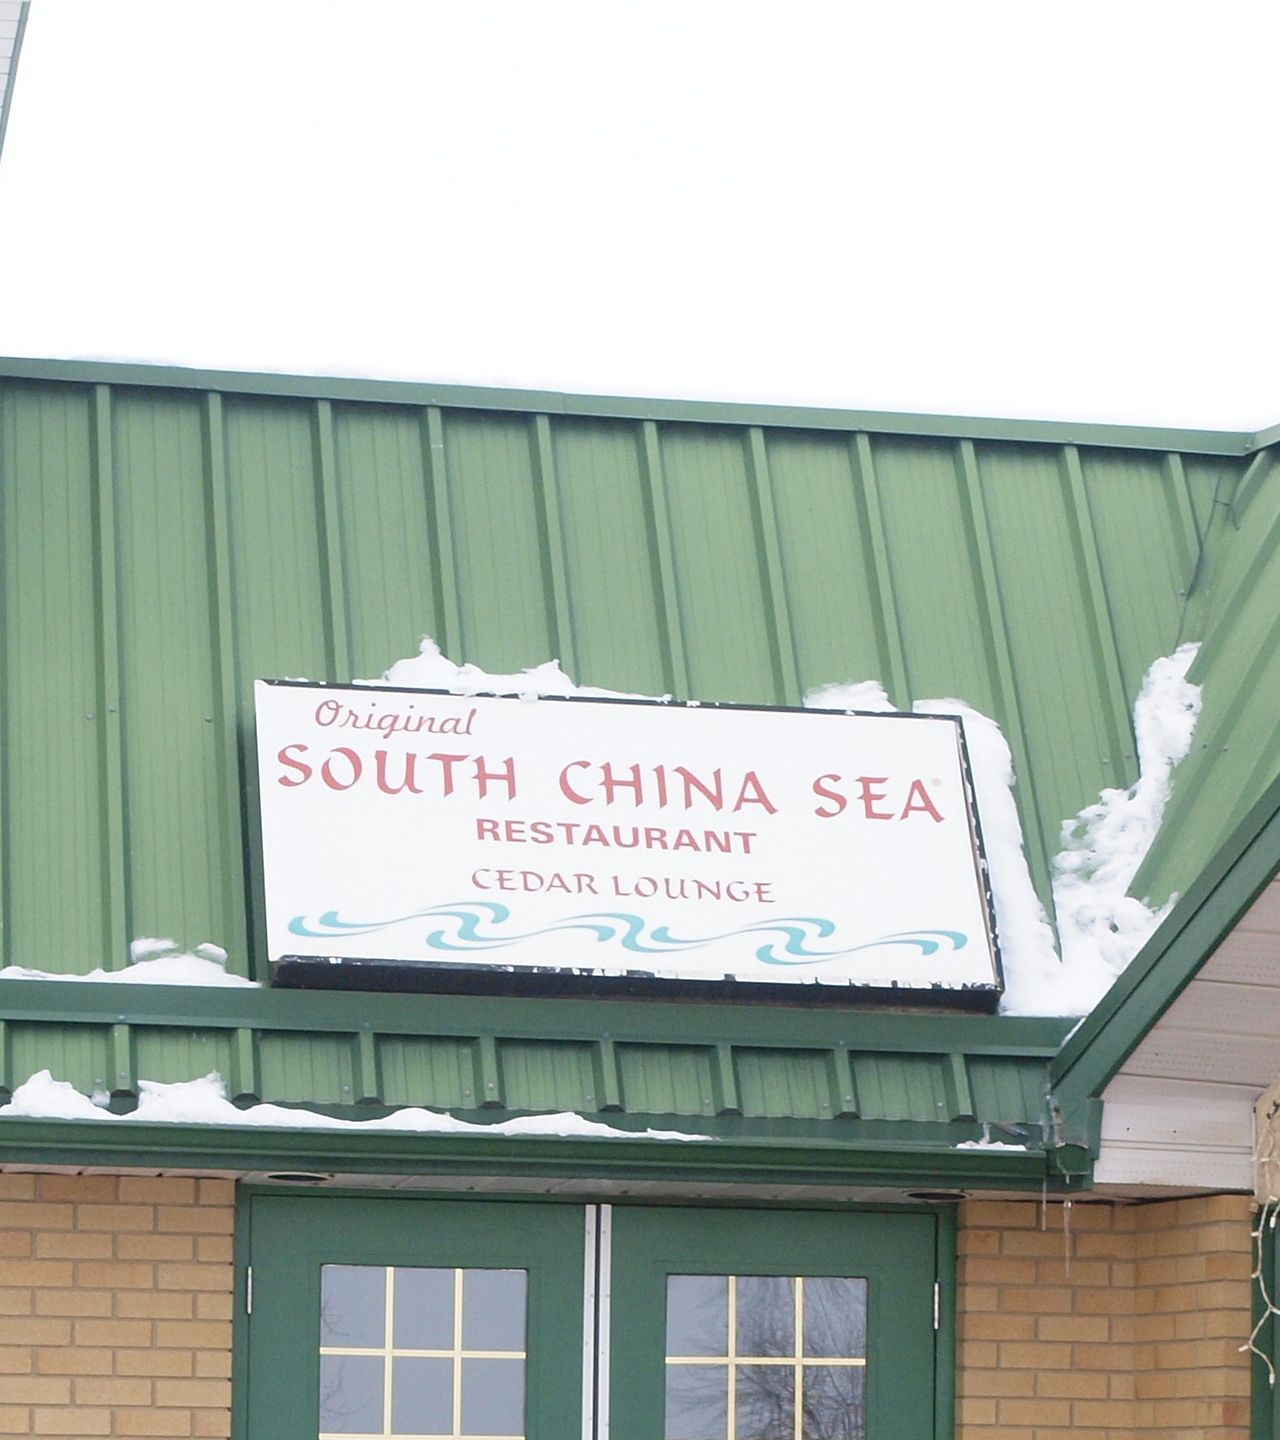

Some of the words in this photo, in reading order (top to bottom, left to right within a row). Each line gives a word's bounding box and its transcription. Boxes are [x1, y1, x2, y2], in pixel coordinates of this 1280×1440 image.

[314, 699, 477, 739] Original
[277, 743, 518, 800] SOUTH
[558, 760, 778, 816] CHINA
[811, 772, 946, 824] SEA
[475, 818, 756, 855] RESTAURANT
[470, 868, 596, 895] CEDAR
[613, 876, 776, 904] LOUNGE
